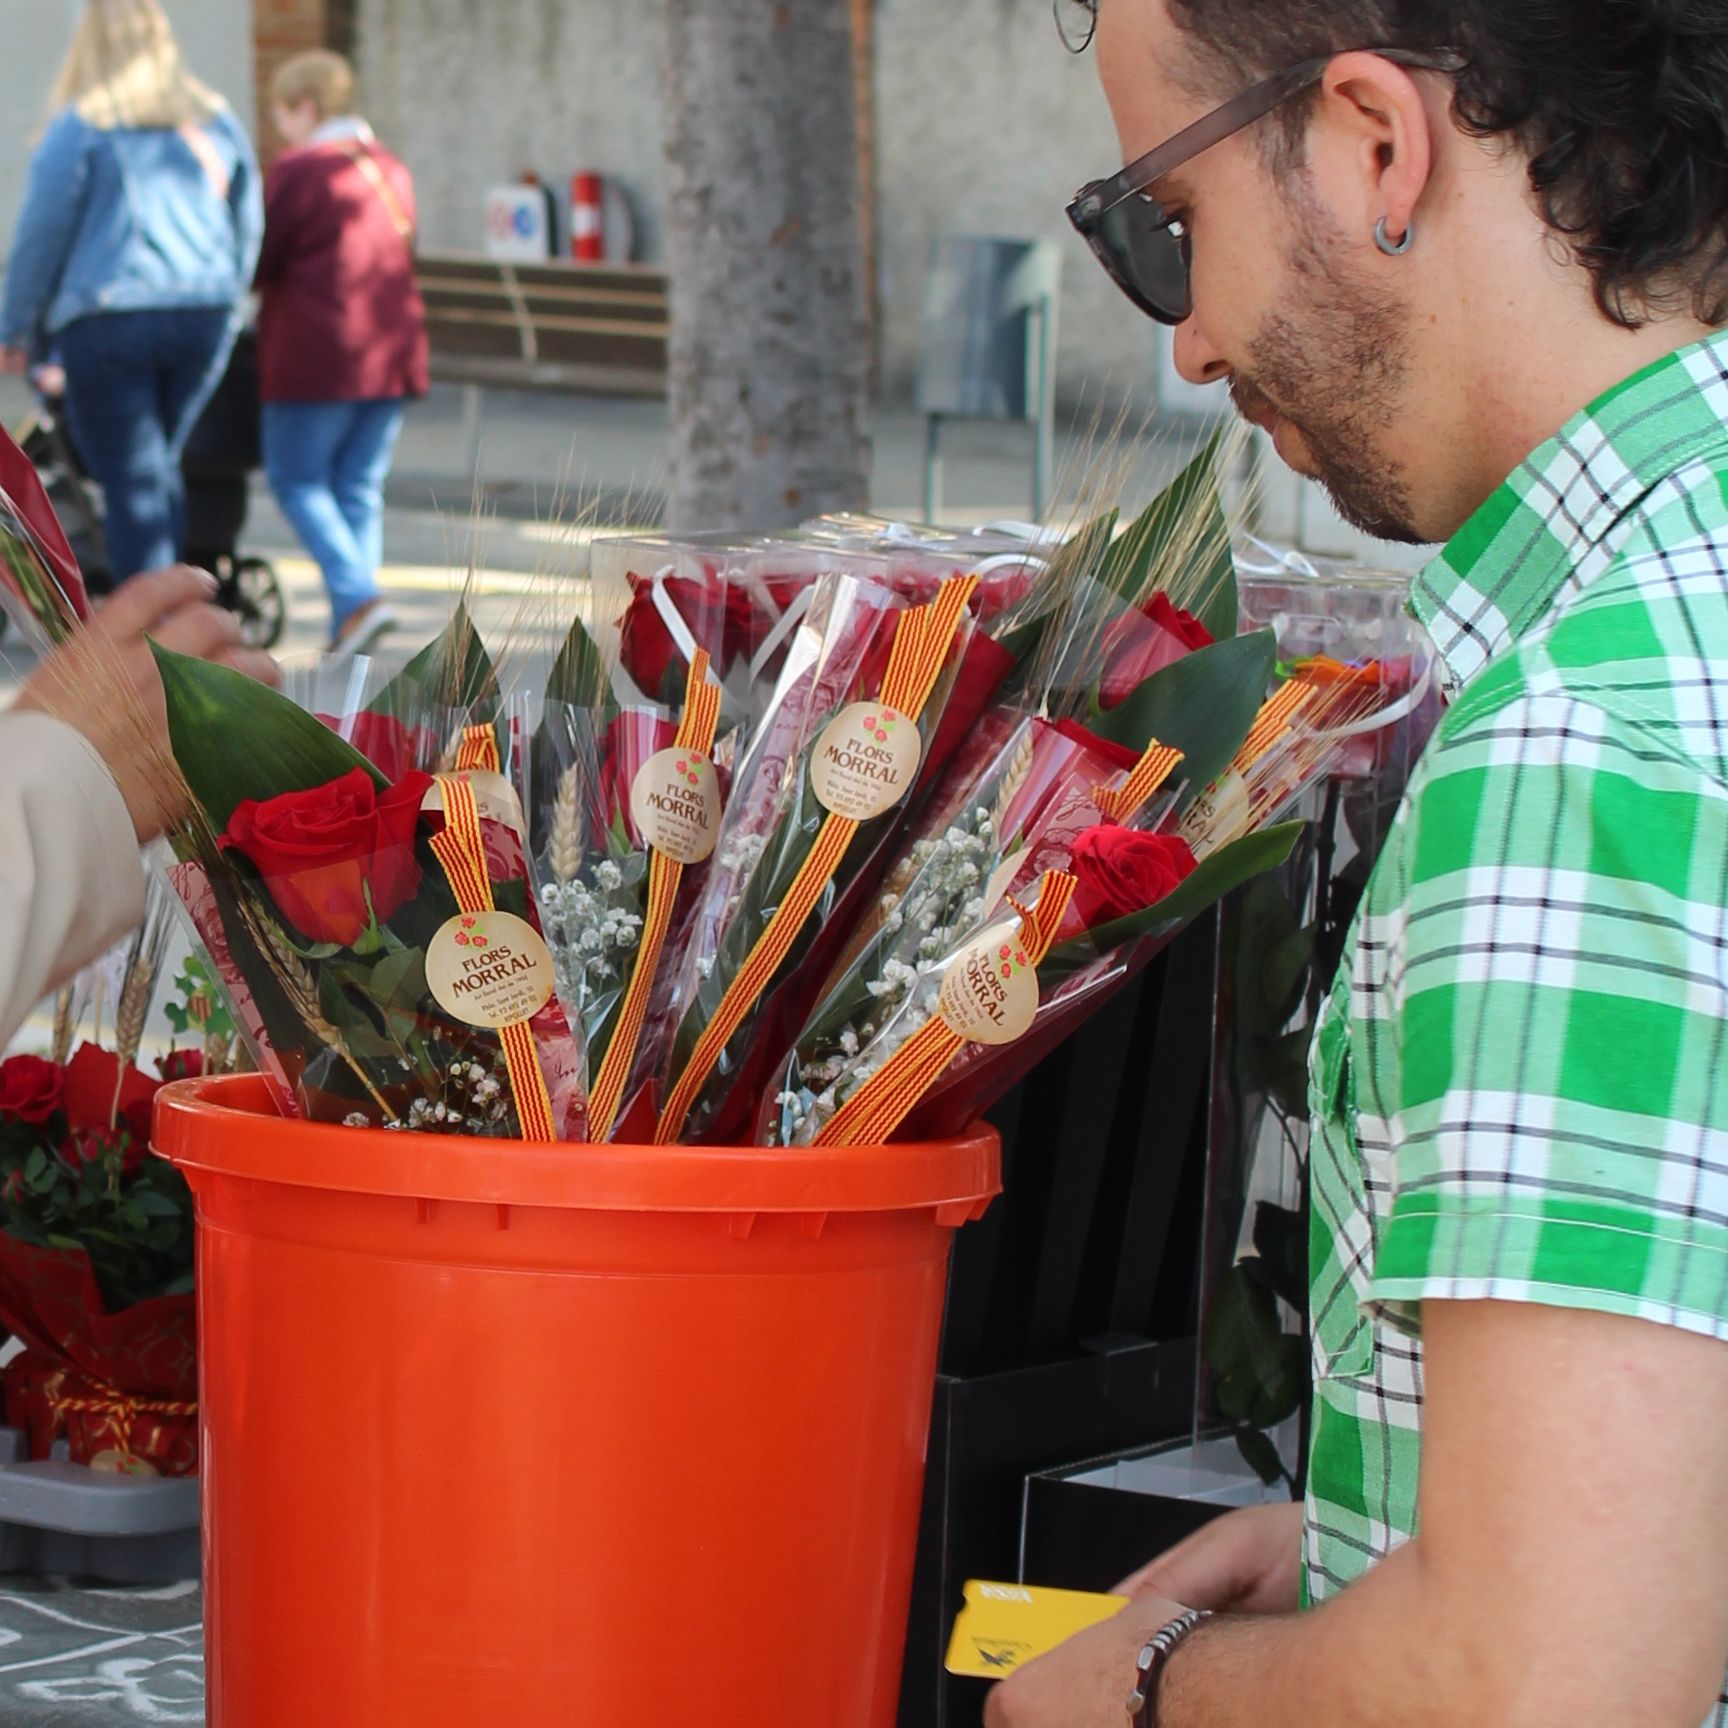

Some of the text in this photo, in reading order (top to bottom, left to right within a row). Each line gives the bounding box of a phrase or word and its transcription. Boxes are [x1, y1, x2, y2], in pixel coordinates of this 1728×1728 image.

[824, 745, 899, 785] MORRAL
[846, 738, 893, 764] FLORS
[646, 792, 709, 830] MORRAL
[666, 784, 705, 807] FLORS
[452, 953, 537, 998] MORRAL
[462, 945, 512, 972] FLORS
[979, 953, 1007, 1002] FLORS
[967, 947, 1007, 1026] MORRAL
